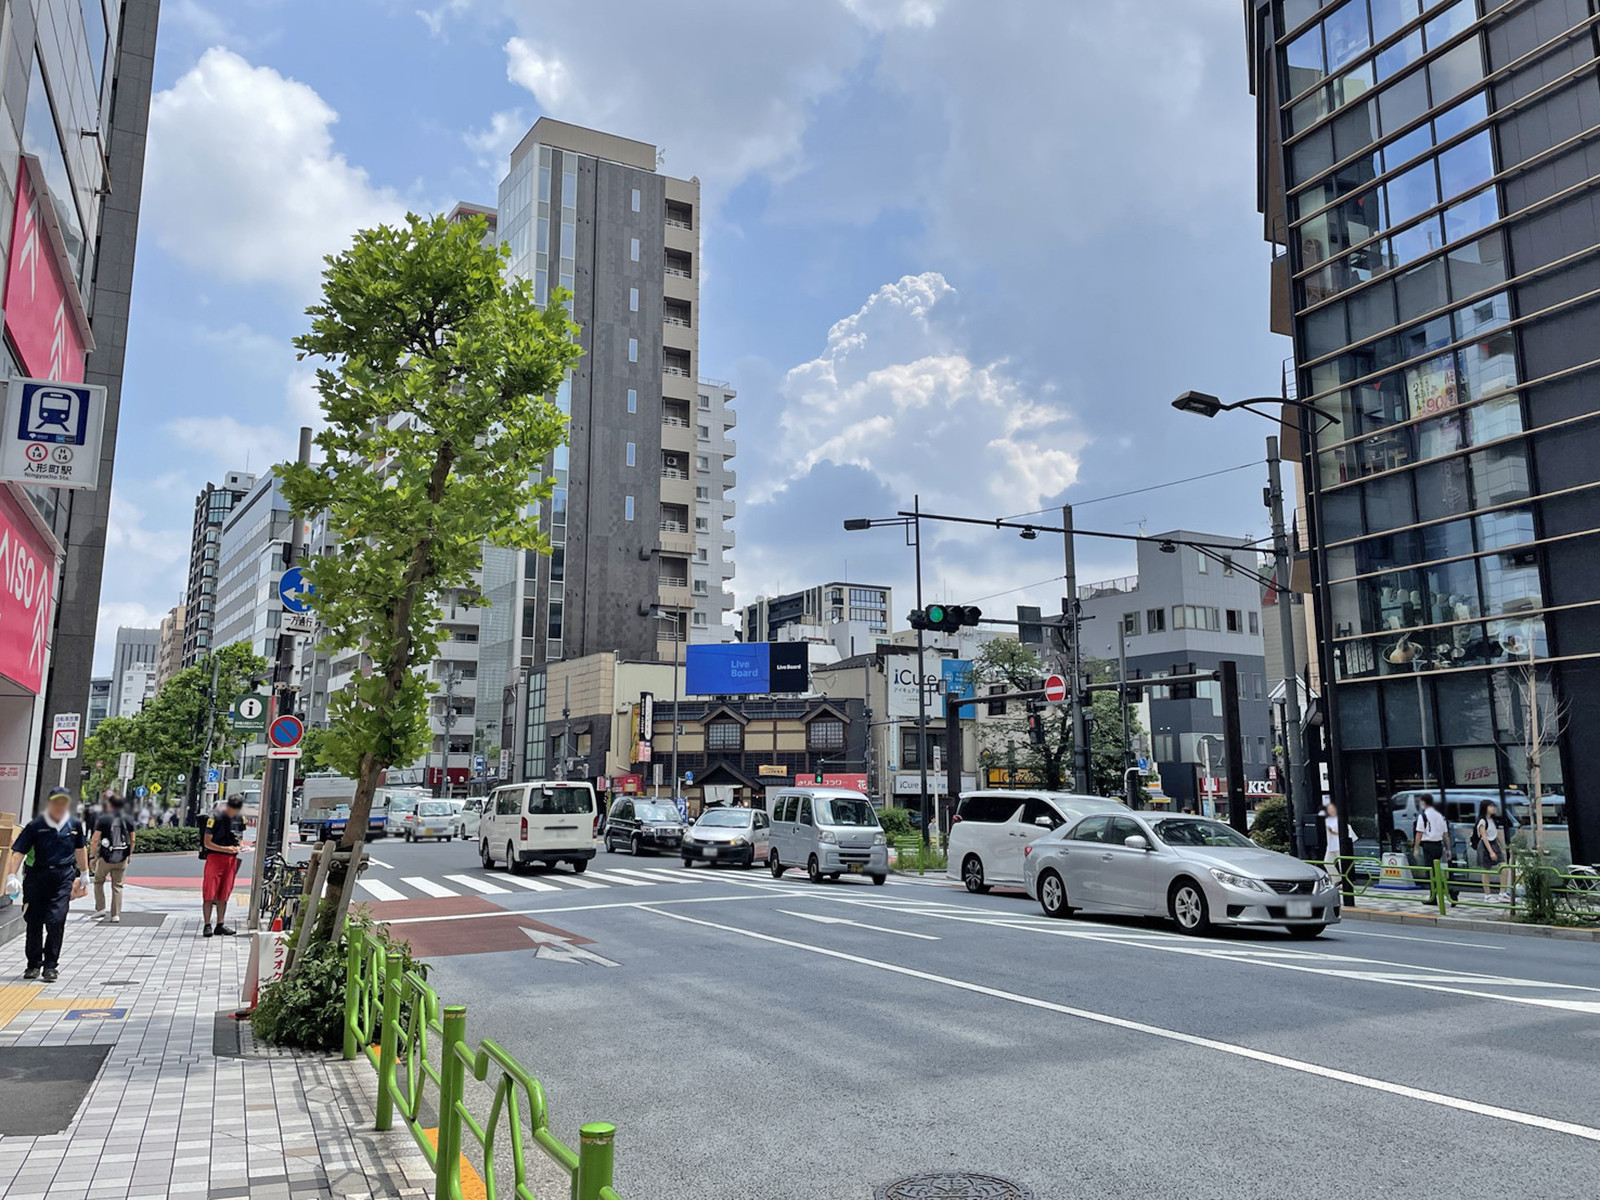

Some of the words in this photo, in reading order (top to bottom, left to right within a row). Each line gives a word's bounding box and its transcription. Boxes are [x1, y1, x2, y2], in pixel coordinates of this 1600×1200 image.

[24, 462, 73, 475] 人形町駅
[284, 615, 313, 628] 一方通行
[731, 660, 750, 668] Live
[731, 669, 759, 677] Board
[857, 780, 868, 789] 花
[1248, 781, 1273, 793] KFC
